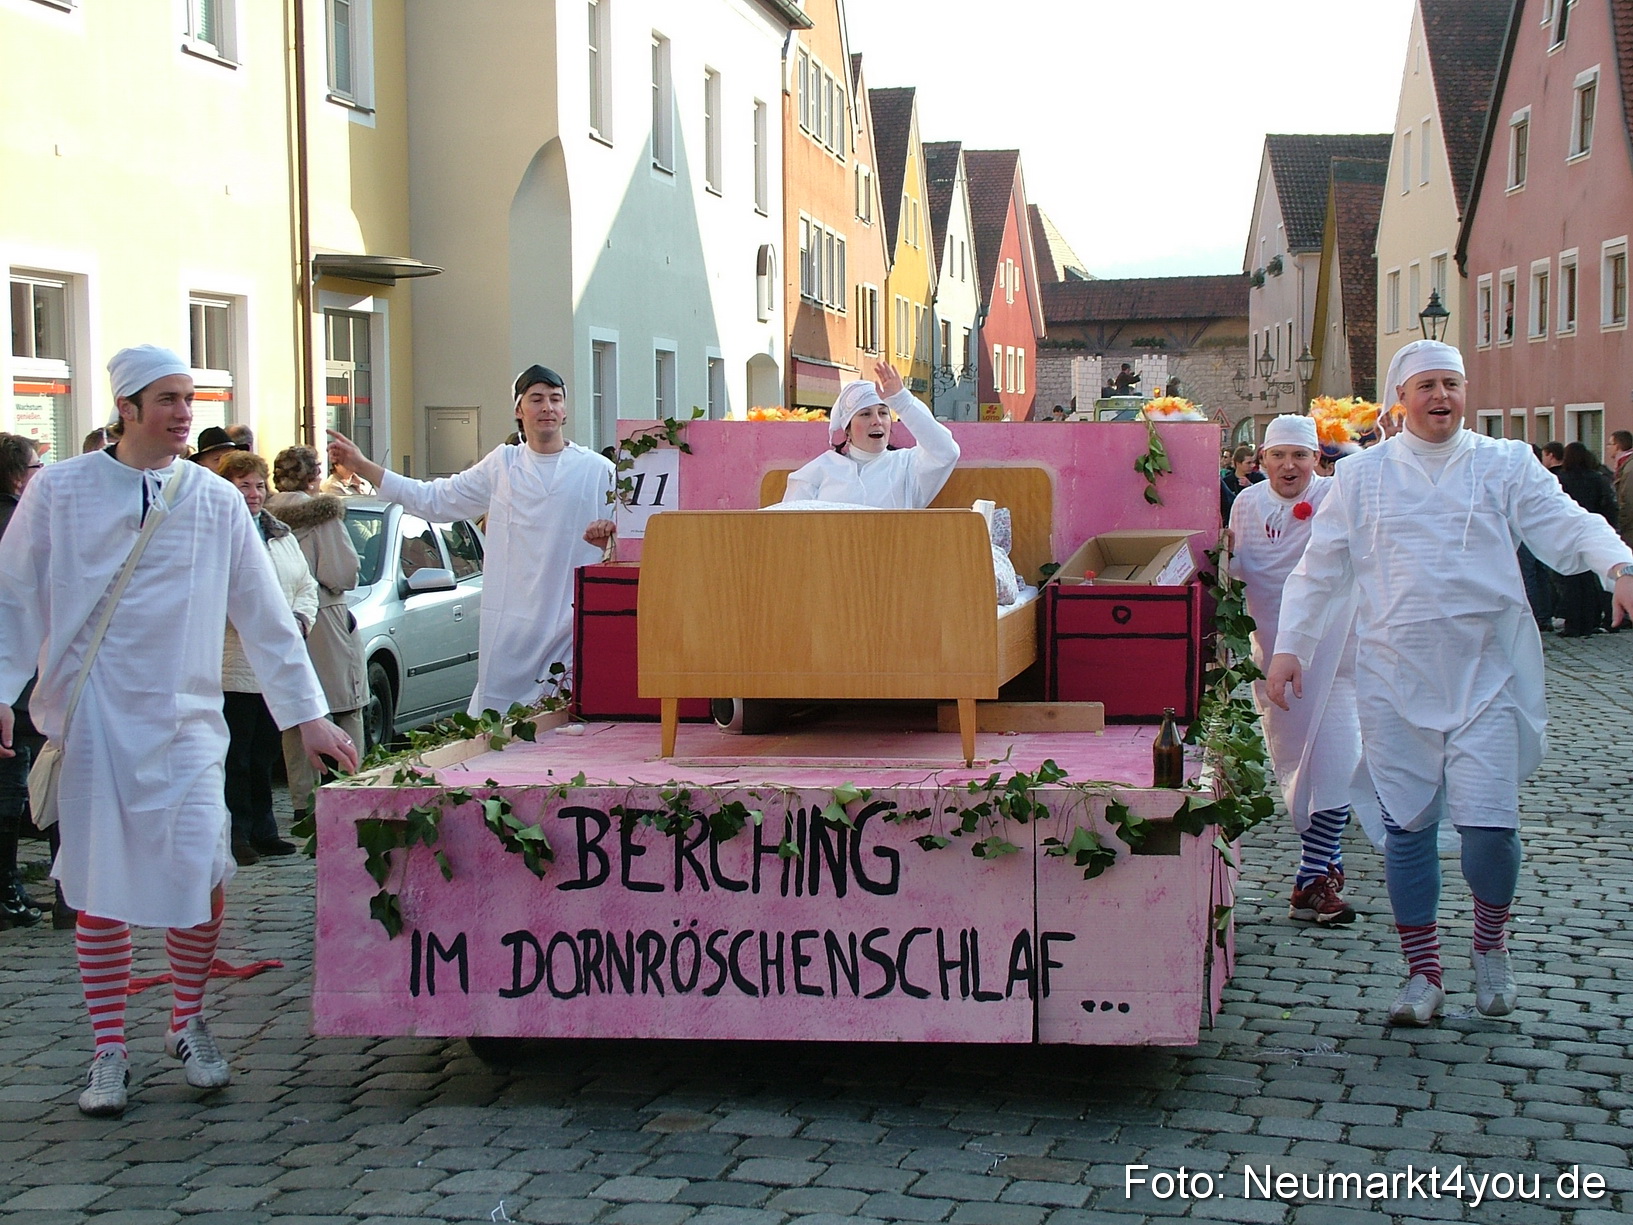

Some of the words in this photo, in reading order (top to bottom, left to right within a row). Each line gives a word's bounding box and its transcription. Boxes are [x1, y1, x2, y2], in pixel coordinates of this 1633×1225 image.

[626, 473, 669, 507] 11
[556, 800, 900, 898] BERCHING
[410, 928, 469, 997] IM
[499, 919, 1076, 1001] DORNRÖSCHENSCHLAF
